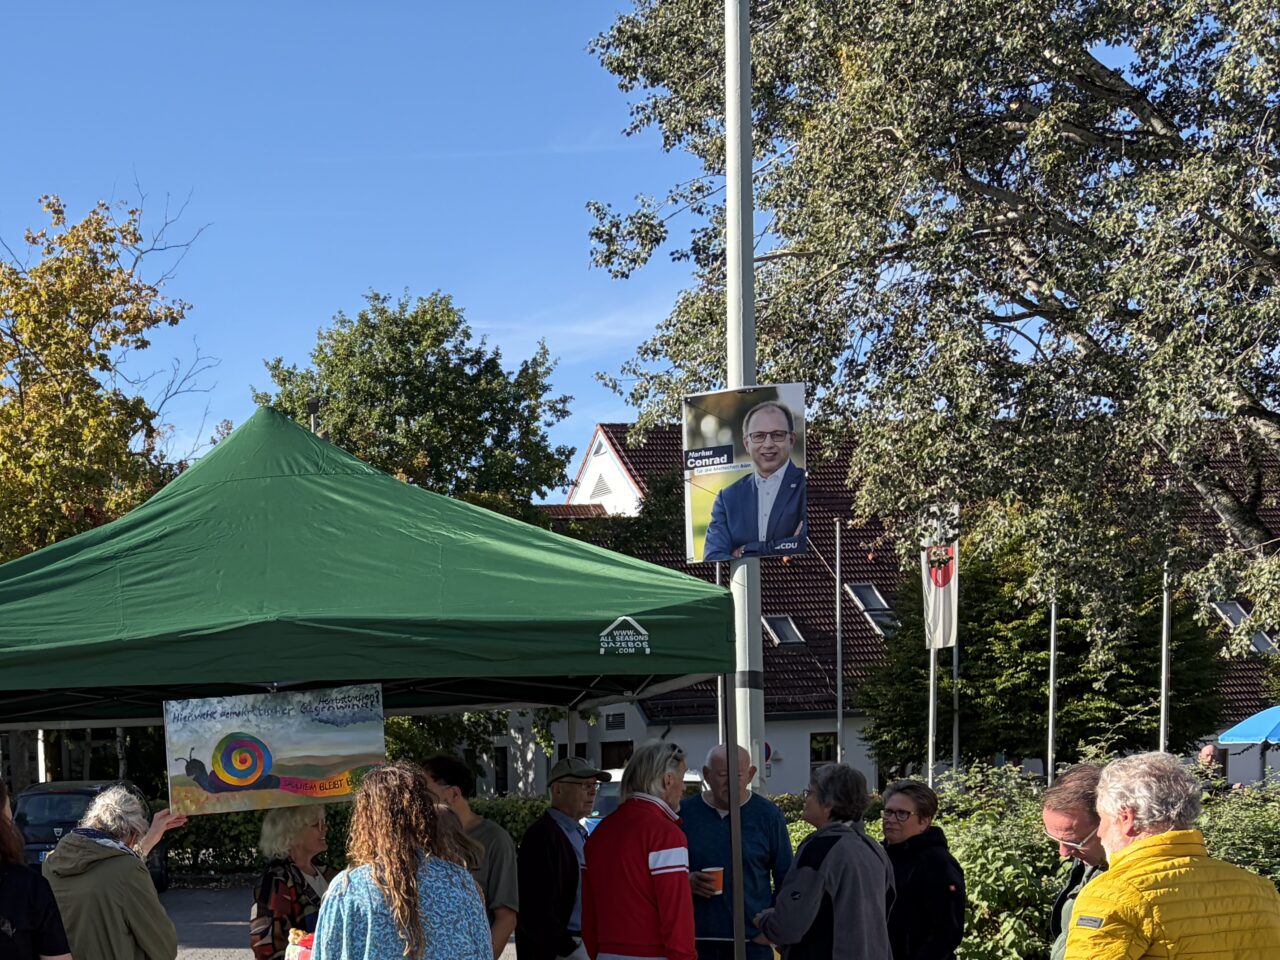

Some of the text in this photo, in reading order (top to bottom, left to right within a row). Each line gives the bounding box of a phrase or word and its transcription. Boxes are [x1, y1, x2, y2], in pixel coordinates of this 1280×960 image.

[687, 454, 728, 468] Conrad
[688, 450, 714, 459] Markus
[172, 710, 192, 723] Hier
[319, 778, 344, 791] BLEIBT
